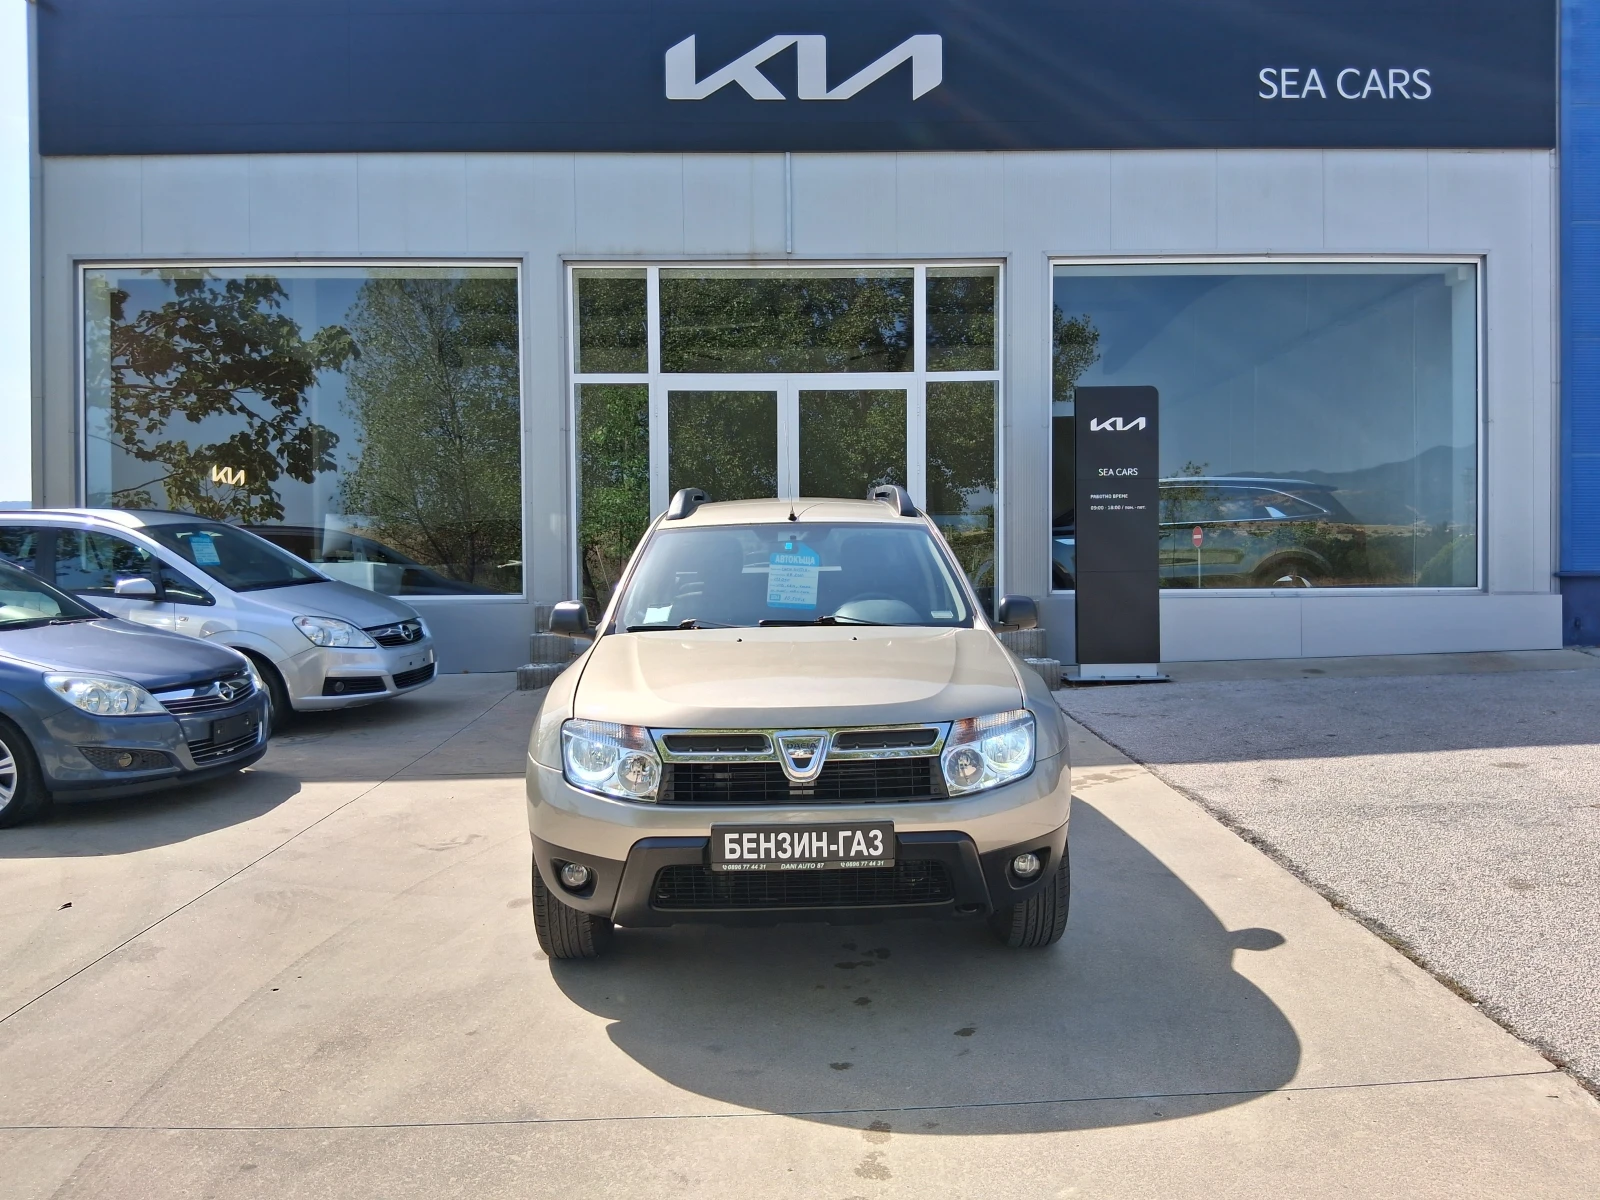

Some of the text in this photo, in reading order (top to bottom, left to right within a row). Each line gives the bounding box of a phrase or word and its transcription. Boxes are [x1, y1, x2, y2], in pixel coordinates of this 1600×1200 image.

[665, 34, 943, 101] KIA
[1258, 67, 1433, 101] SEA CARS
[1090, 416, 1146, 431] KIA
[211, 465, 246, 487] KIA
[1098, 468, 1139, 477] SEA CARS
[775, 554, 816, 566] АВТОКЪЩА
[724, 829, 884, 860] БЕНЗИН-ГАЗ
